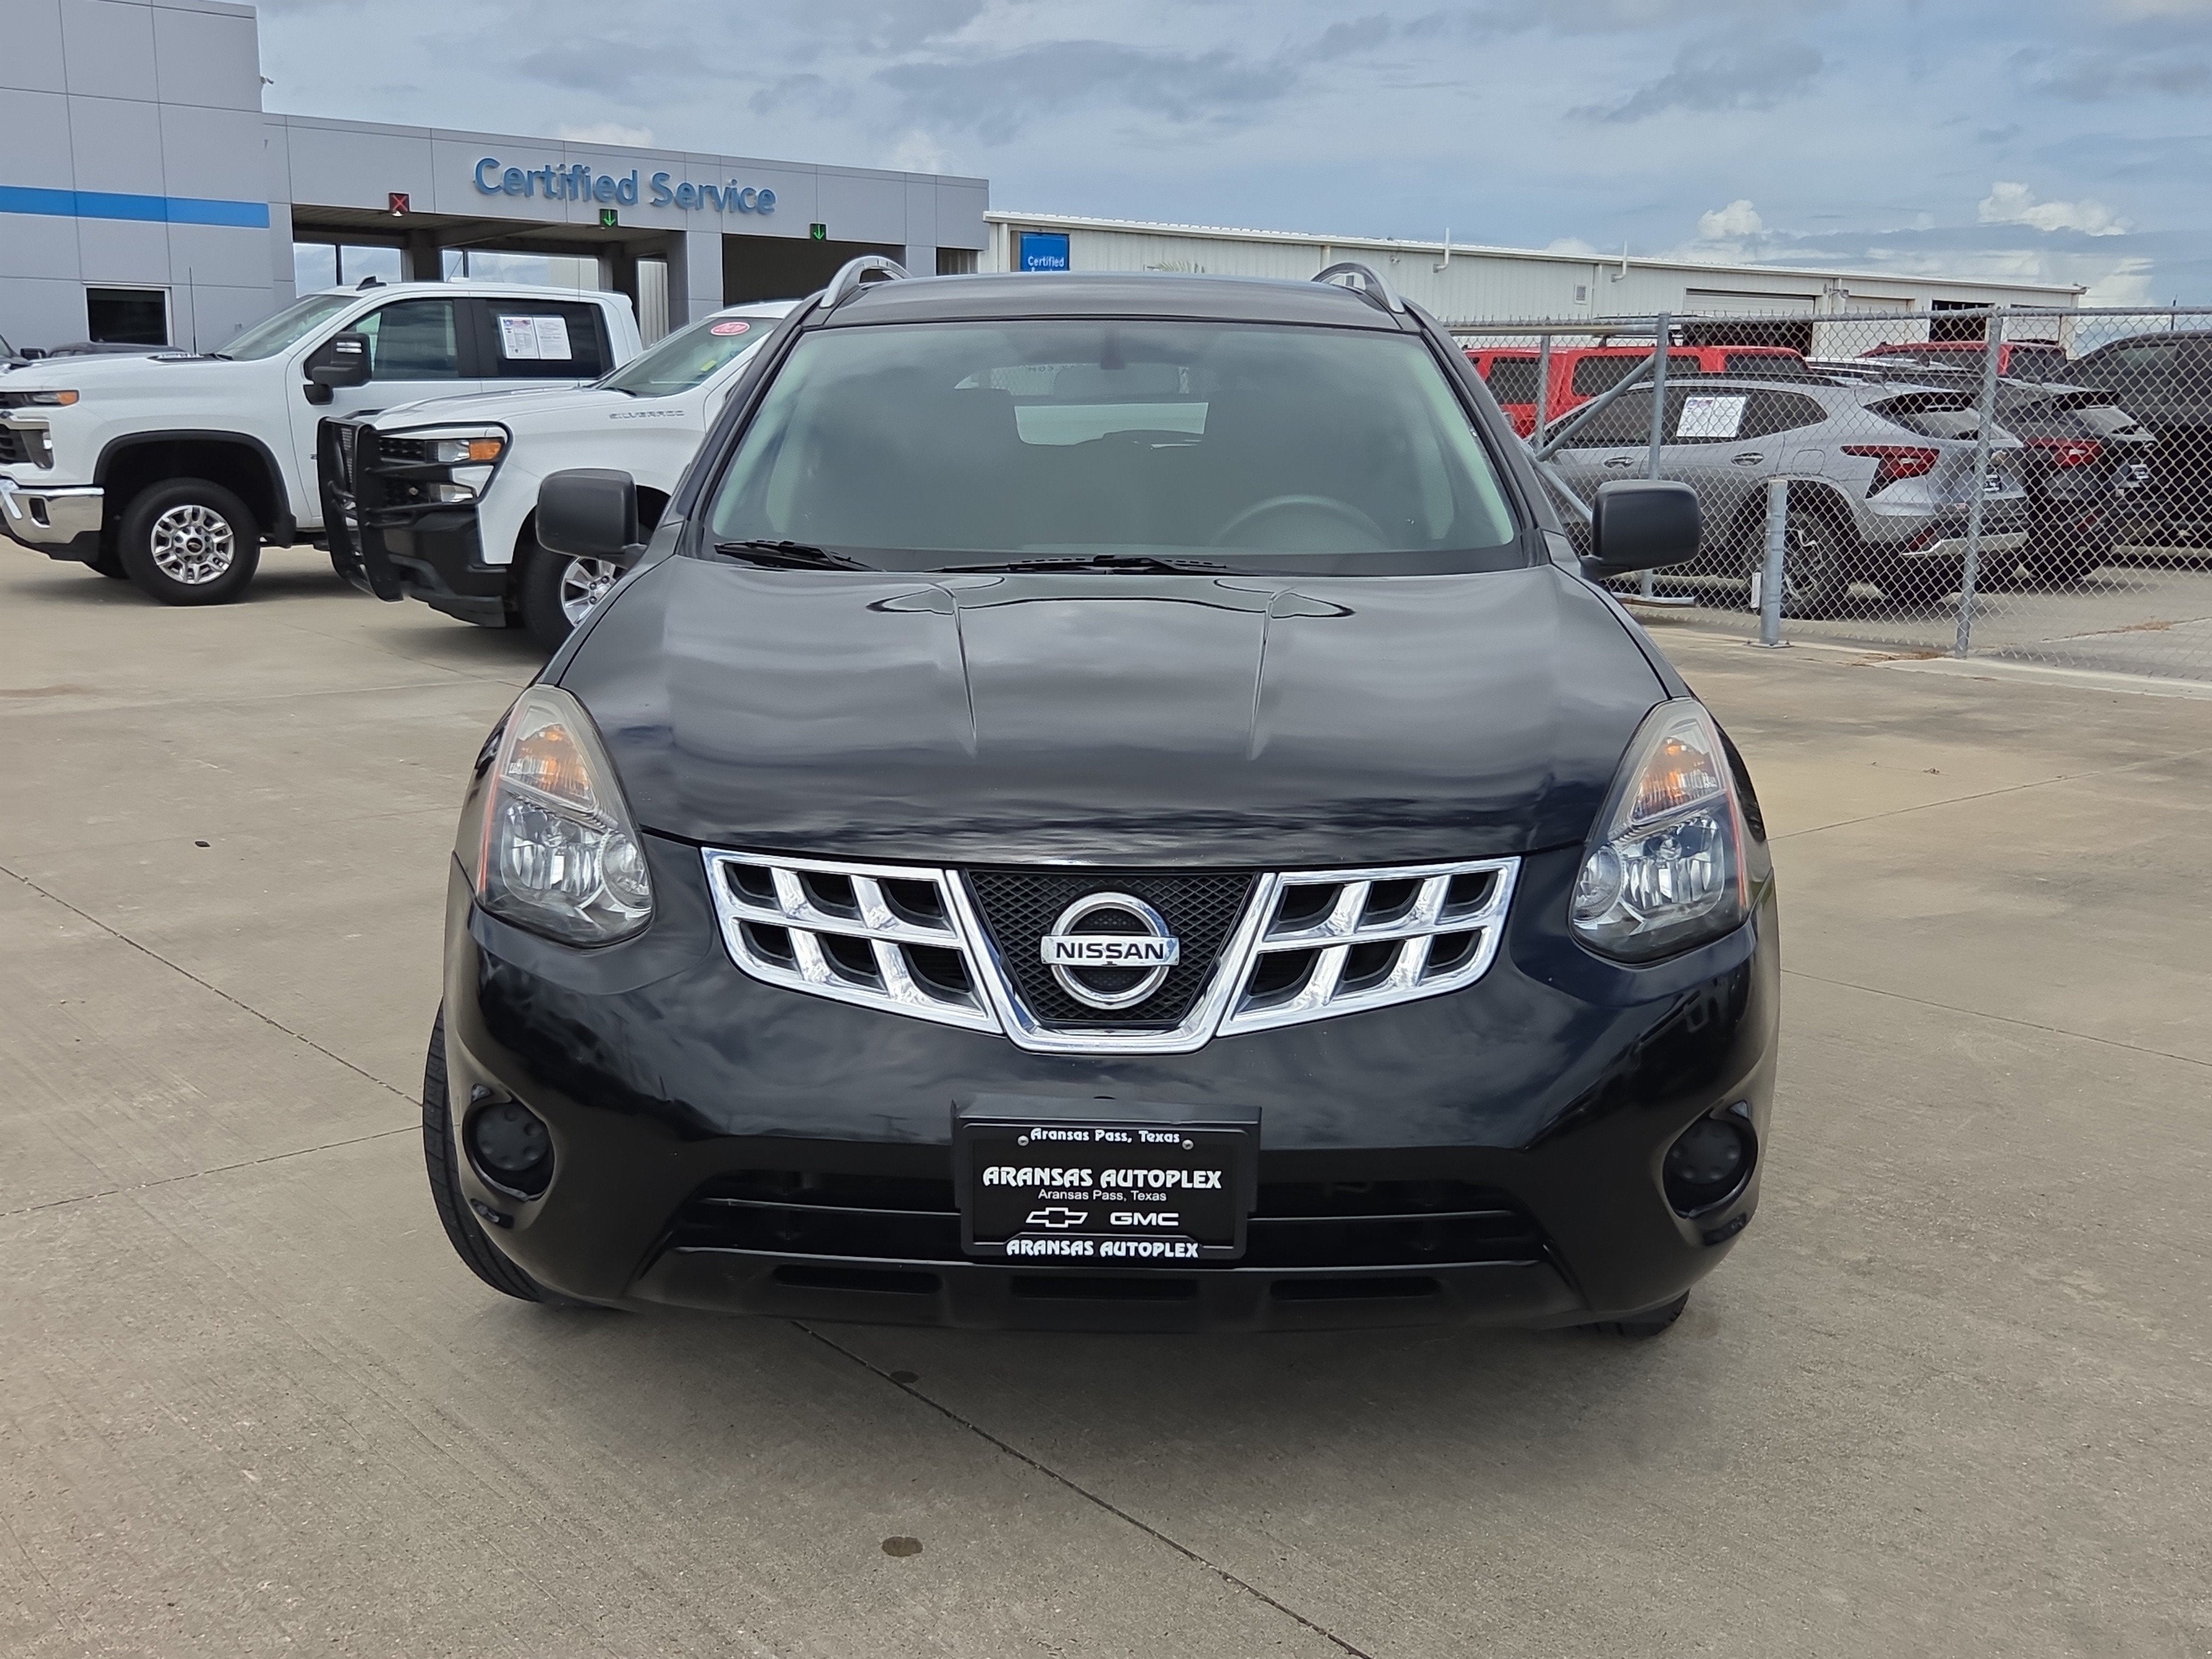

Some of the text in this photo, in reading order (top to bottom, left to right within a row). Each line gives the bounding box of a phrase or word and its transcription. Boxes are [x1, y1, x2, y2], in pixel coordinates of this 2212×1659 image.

[474, 157, 776, 215] Certified Service
[1027, 256, 1065, 268] Certified
[1056, 942, 1164, 960] NISSAN
[1031, 1128, 1180, 1144] Aransas Pass, Texas
[982, 1166, 1222, 1189] ARANSAS AUTOPLEX
[1038, 1189, 1167, 1202] Aransas Pass, Texas
[1110, 1212, 1179, 1226] GMC
[1006, 1239, 1199, 1258] ARANSAS AUTOPLEX
